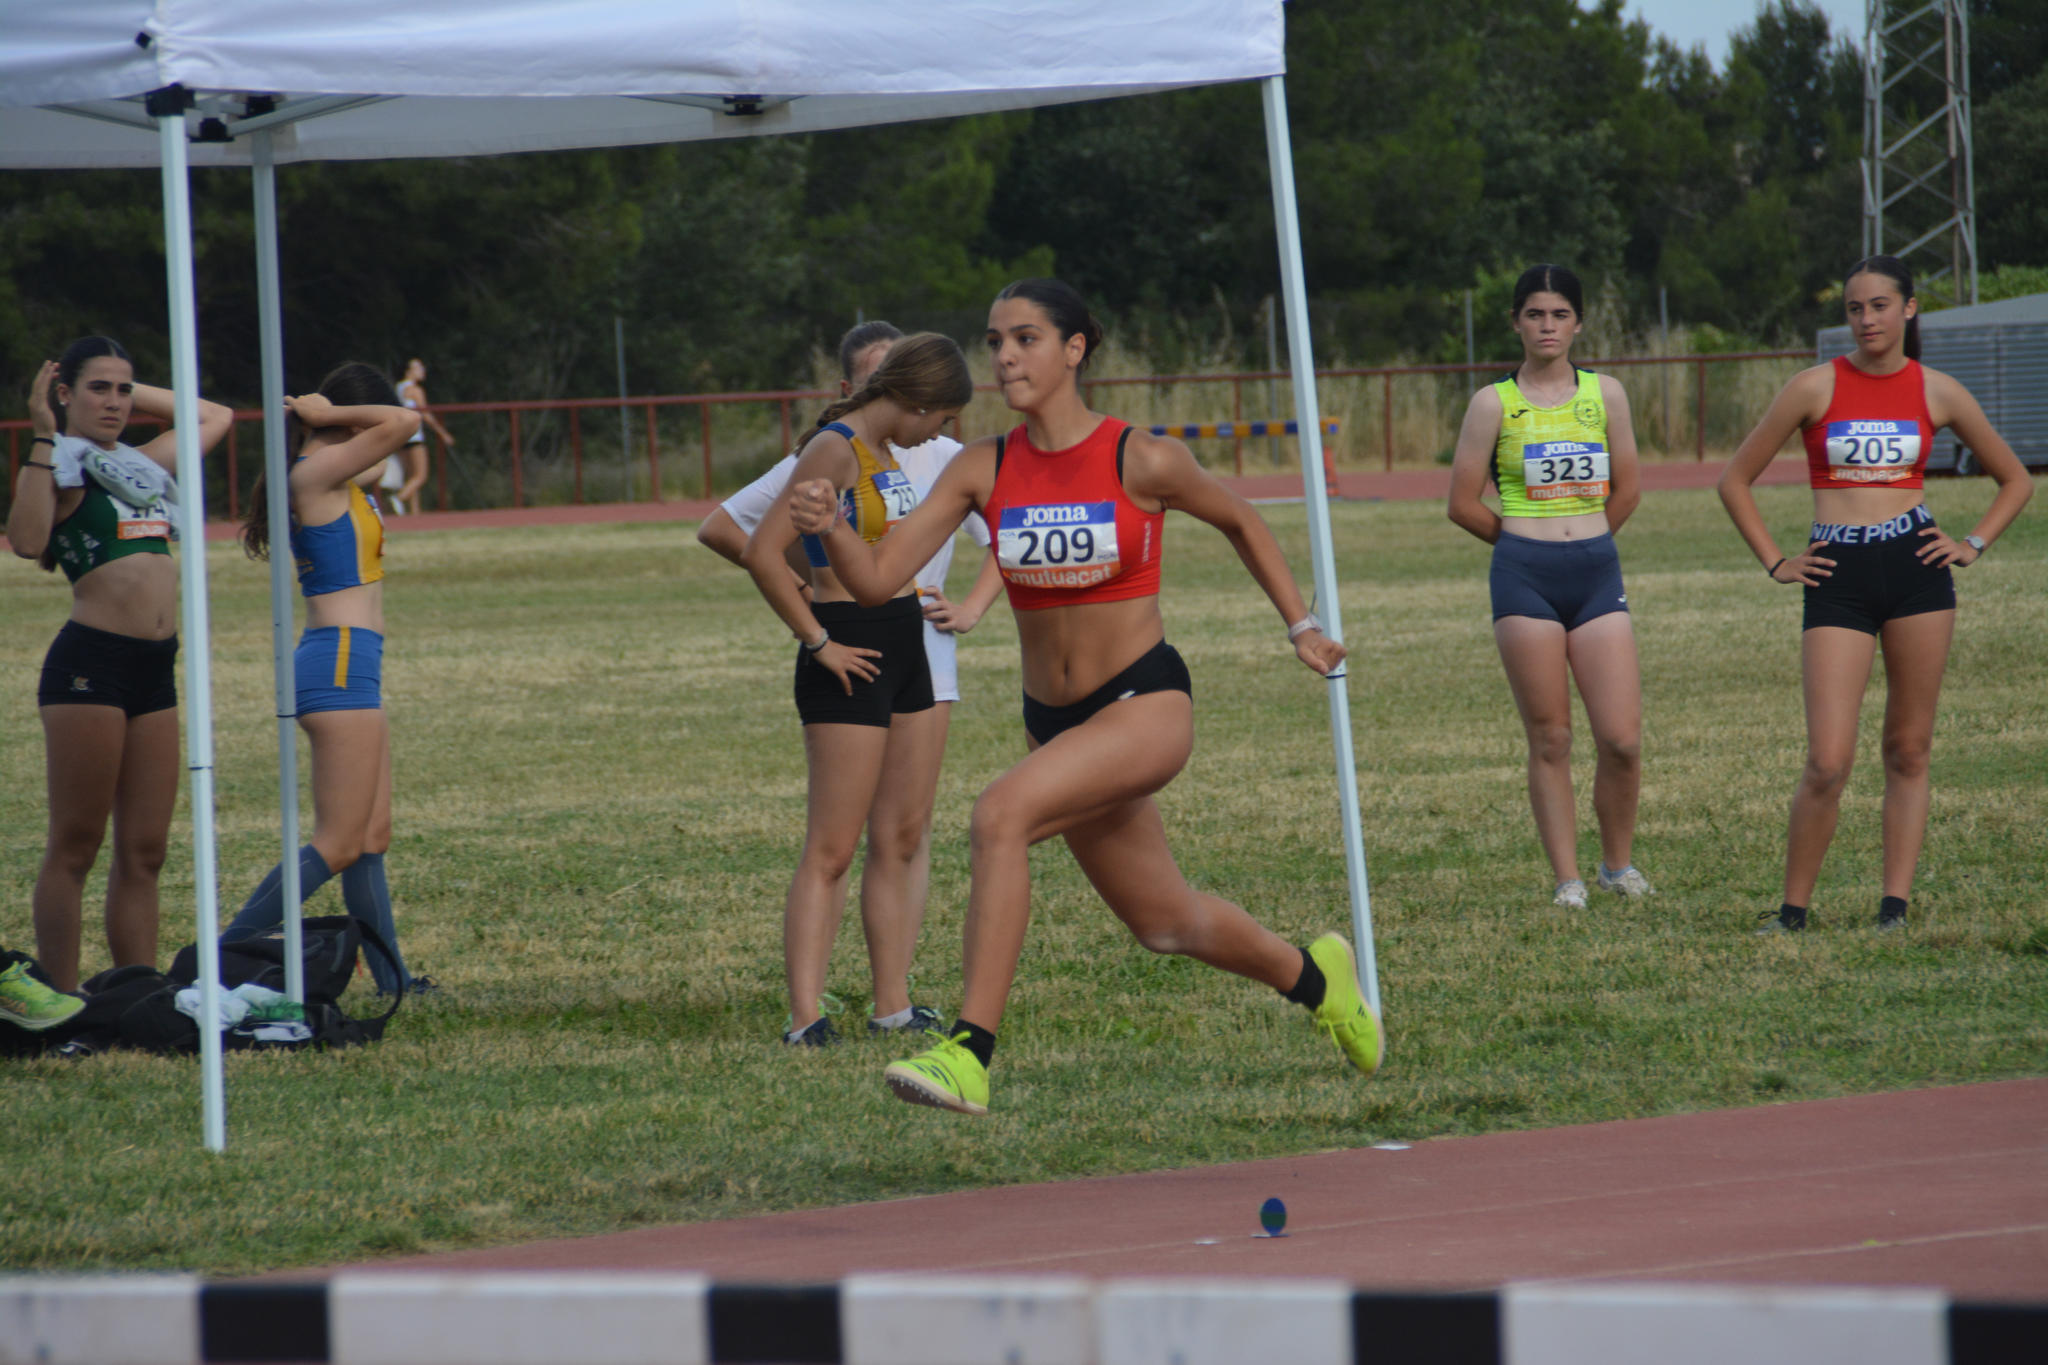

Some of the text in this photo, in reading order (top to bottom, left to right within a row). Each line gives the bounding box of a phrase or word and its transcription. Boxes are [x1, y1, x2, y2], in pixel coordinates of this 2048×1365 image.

[1844, 437, 1903, 464] 205
[1540, 456, 1594, 483] 323
[1531, 483, 1604, 499] mutuacat
[1811, 521, 1861, 543] NIKE
[1863, 513, 1912, 543] PRO
[1018, 527, 1095, 566] 209
[1010, 565, 1112, 585] mutuacat
